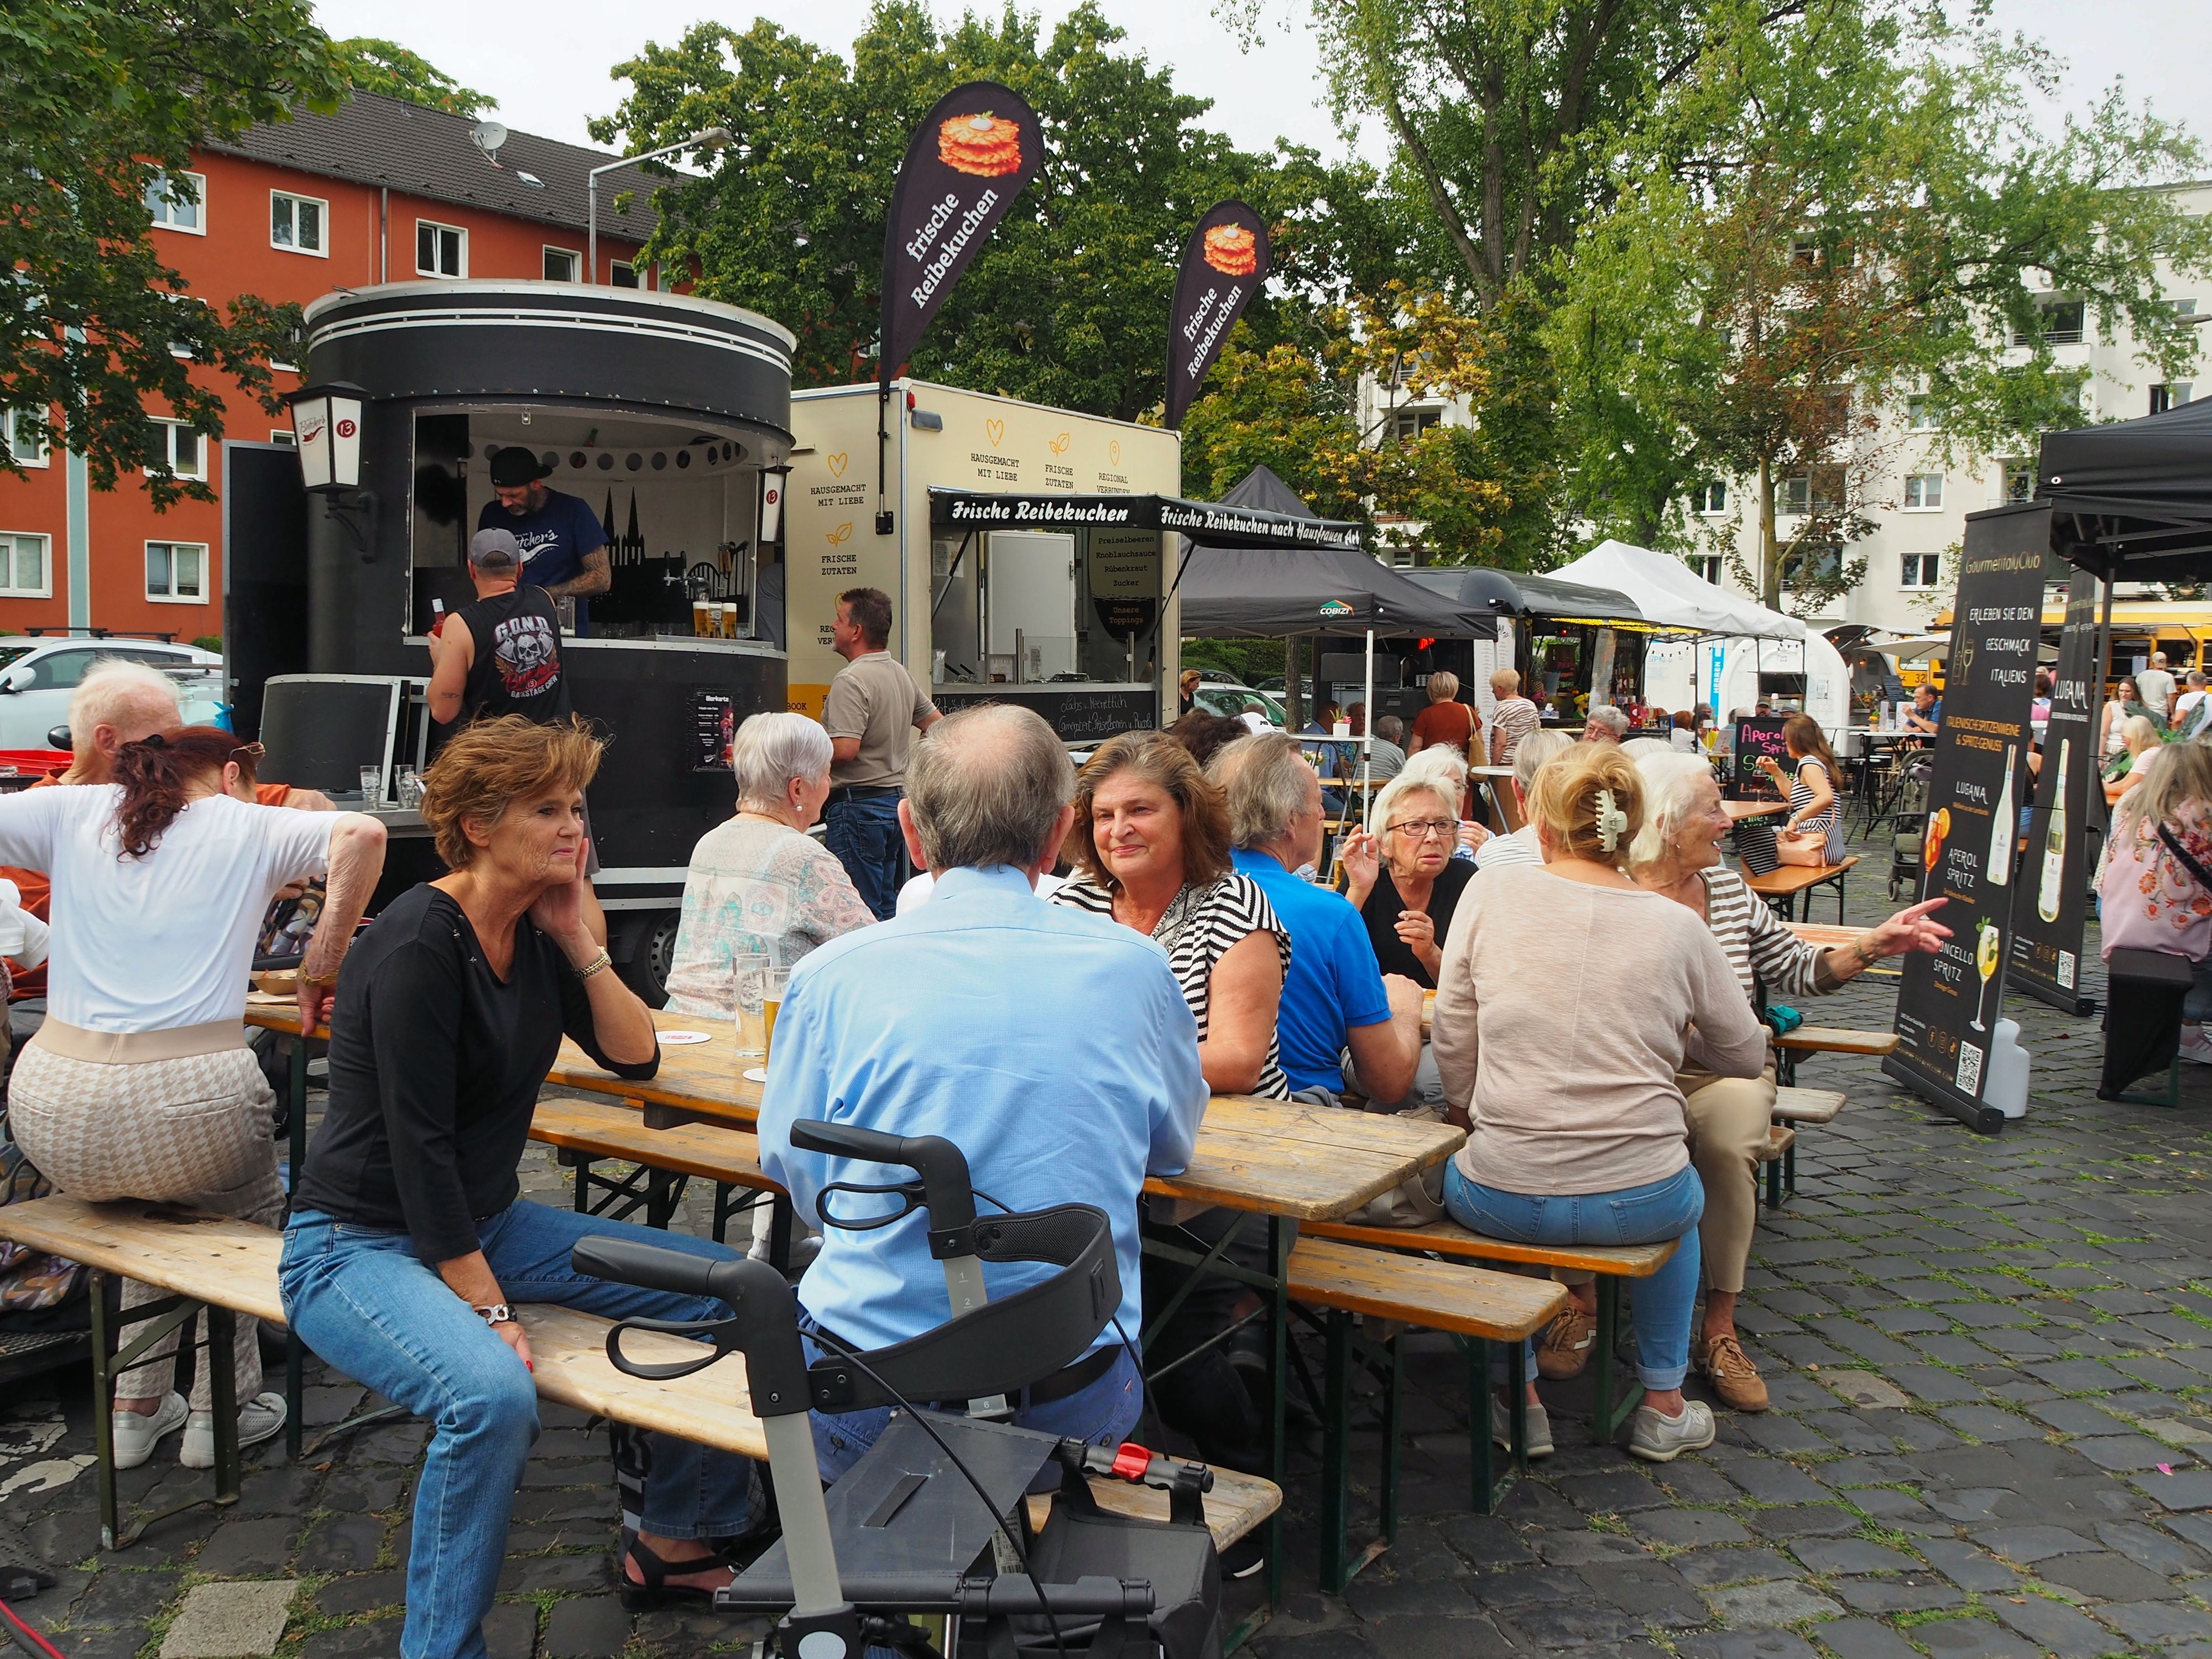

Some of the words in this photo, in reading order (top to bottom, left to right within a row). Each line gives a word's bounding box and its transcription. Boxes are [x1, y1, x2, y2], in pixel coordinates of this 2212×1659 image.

[906, 194, 959, 263] frische
[911, 189, 999, 309] Reibekuchen
[1183, 288, 1217, 342] frische
[1187, 285, 1242, 379] Reibekuchen
[340, 422, 352, 435] 13
[971, 453, 1019, 467] HAUSGEMACHT
[978, 468, 992, 478] MIT
[996, 471, 1018, 481] LIEBE
[1045, 465, 1073, 476] FRISCHE
[1099, 473, 1128, 484] REGIONAL
[811, 484, 867, 494] HAUSGEMACHT
[1045, 478, 1073, 489] ZUTATEN
[838, 497, 864, 505] LIEBE
[952, 500, 1010, 519] Frische
[1015, 501, 1129, 521] Reibekuchen
[1161, 505, 1202, 528] Frische
[1204, 510, 1269, 535] Reibekuchen
[1271, 520, 1293, 537] nach
[1296, 521, 1343, 544] Hausfrauen
[1344, 529, 1360, 546] Art
[821, 555, 857, 563] FRISCHE
[822, 567, 857, 575] ZUTATEN
[1109, 617, 1144, 625] Toppings
[1969, 608, 2001, 625] ERLEBEN
[2002, 608, 2016, 620] SIE
[2017, 607, 2034, 620] DEN
[1986, 638, 2031, 656] GESCHMACK
[511, 686, 546, 698] BACKSTAGE
[545, 675, 558, 688] CREW
[1991, 669, 2027, 687] ITALIENS
[2054, 680, 2088, 709] LUGANA
[1741, 724, 1785, 743] Aperol
[1956, 781, 1989, 805] LUGANA
[1948, 848, 1978, 870] APEROL
[1947, 868, 1975, 889] SPRITZ
[1933, 959, 1962, 982] SPRITZ
[984, 1401, 990, 1409] 6
